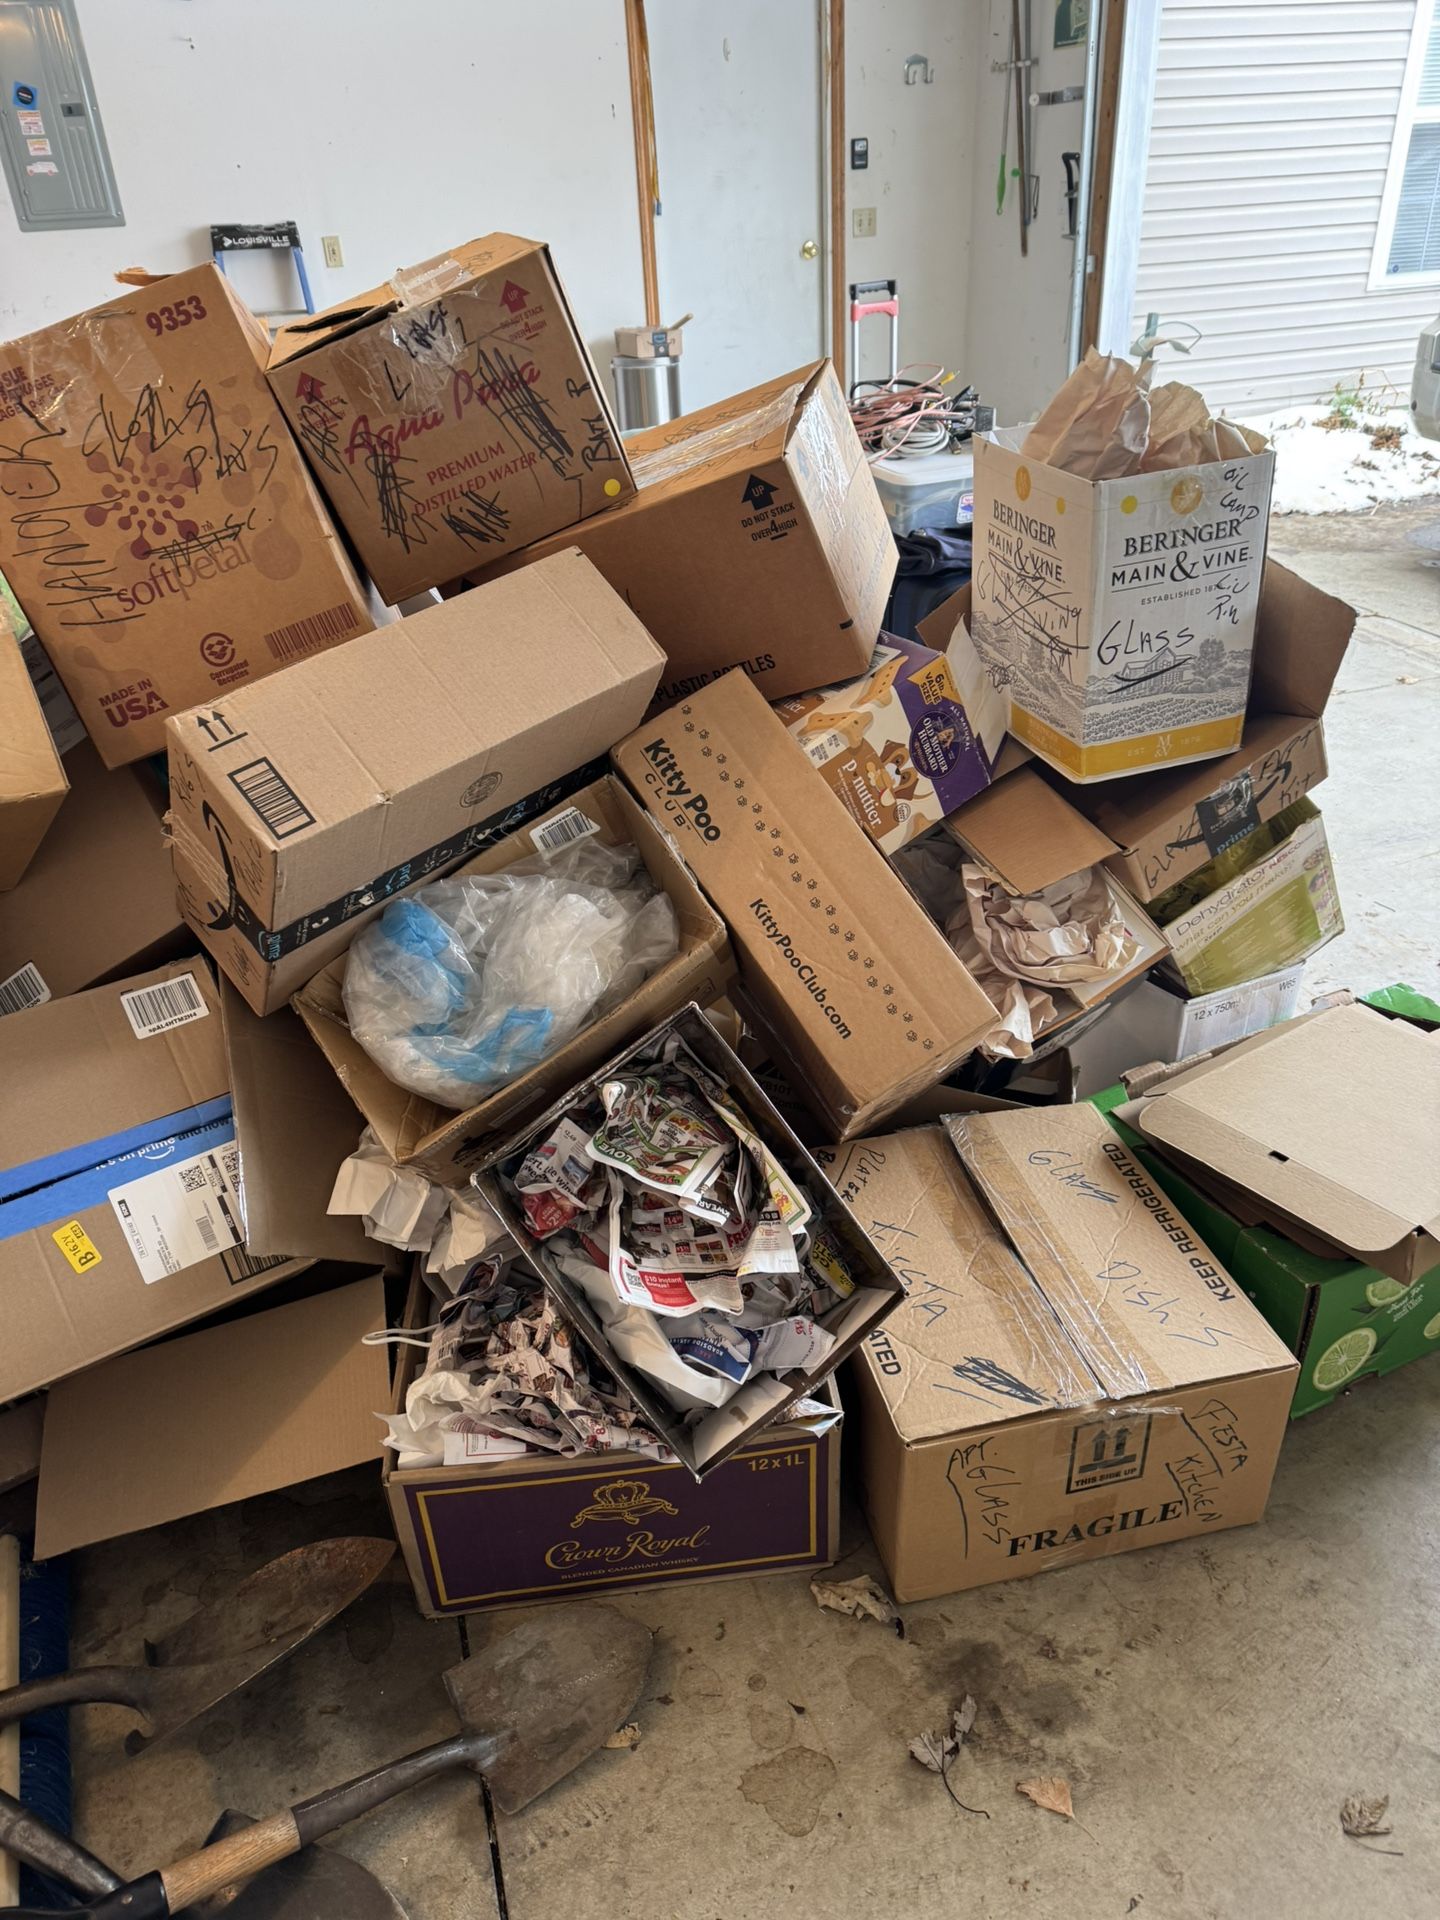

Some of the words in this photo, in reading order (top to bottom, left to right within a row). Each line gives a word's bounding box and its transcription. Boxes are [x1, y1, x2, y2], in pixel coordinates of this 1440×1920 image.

[232, 235, 289, 246] LOUISVILLE
[145, 295, 208, 337] 9353
[344, 409, 445, 466] Aqua
[427, 441, 506, 487] PREMIUM
[413, 473, 487, 518] DISTILLED
[488, 451, 538, 487] WATER
[752, 484, 766, 498] UP
[740, 516, 753, 529] DO
[754, 511, 771, 525] NOT
[770, 501, 796, 519] STACK
[751, 528, 773, 542] OVER
[769, 519, 779, 534] 4
[778, 517, 798, 531] HIGH
[992, 499, 1058, 550] BERINGER
[987, 528, 1012, 557] MAIN
[1012, 537, 1032, 572] &
[1123, 518, 1243, 557] BERINGER
[117, 533, 252, 613] softpetal
[1111, 561, 1166, 587] MAIN
[1169, 550, 1201, 583] &
[1140, 587, 1201, 606] ESTABLISHED
[99, 685, 137, 708] MADE
[136, 677, 153, 692] IN
[924, 671, 941, 704] VALUE
[105, 690, 170, 728] USA
[949, 705, 961, 717] ALL
[917, 728, 939, 772] HUBBARD
[922, 716, 935, 737] OLD
[931, 735, 949, 773] MOTHER
[644, 737, 691, 798] Kitty
[684, 793, 721, 844] Poo
[644, 771, 684, 829] CLUB
[1216, 821, 1257, 857] prime
[1176, 865, 1269, 936] Dehydrator
[750, 897, 854, 1041] KittyPooClub.com
[1193, 1009, 1206, 1021] 12
[1101, 1142, 1200, 1253] REFRIGERATED
[80, 1249, 96, 1268] B
[1198, 1255, 1236, 1302] KEEP
[748, 1459, 769, 1473] 12
[771, 1458, 782, 1470] x
[784, 1454, 805, 1468] 1L
[1074, 1476, 1097, 1488] THIS
[1098, 1471, 1122, 1485] SIDE
[1123, 1467, 1138, 1479] UP
[544, 1539, 628, 1571] Crown
[609, 1525, 711, 1564] Royal
[1005, 1500, 1184, 1558] FRAGILE
[561, 1567, 606, 1580] BLENDED
[607, 1561, 659, 1575] CANADIAN
[659, 1556, 700, 1568] WHISKY
